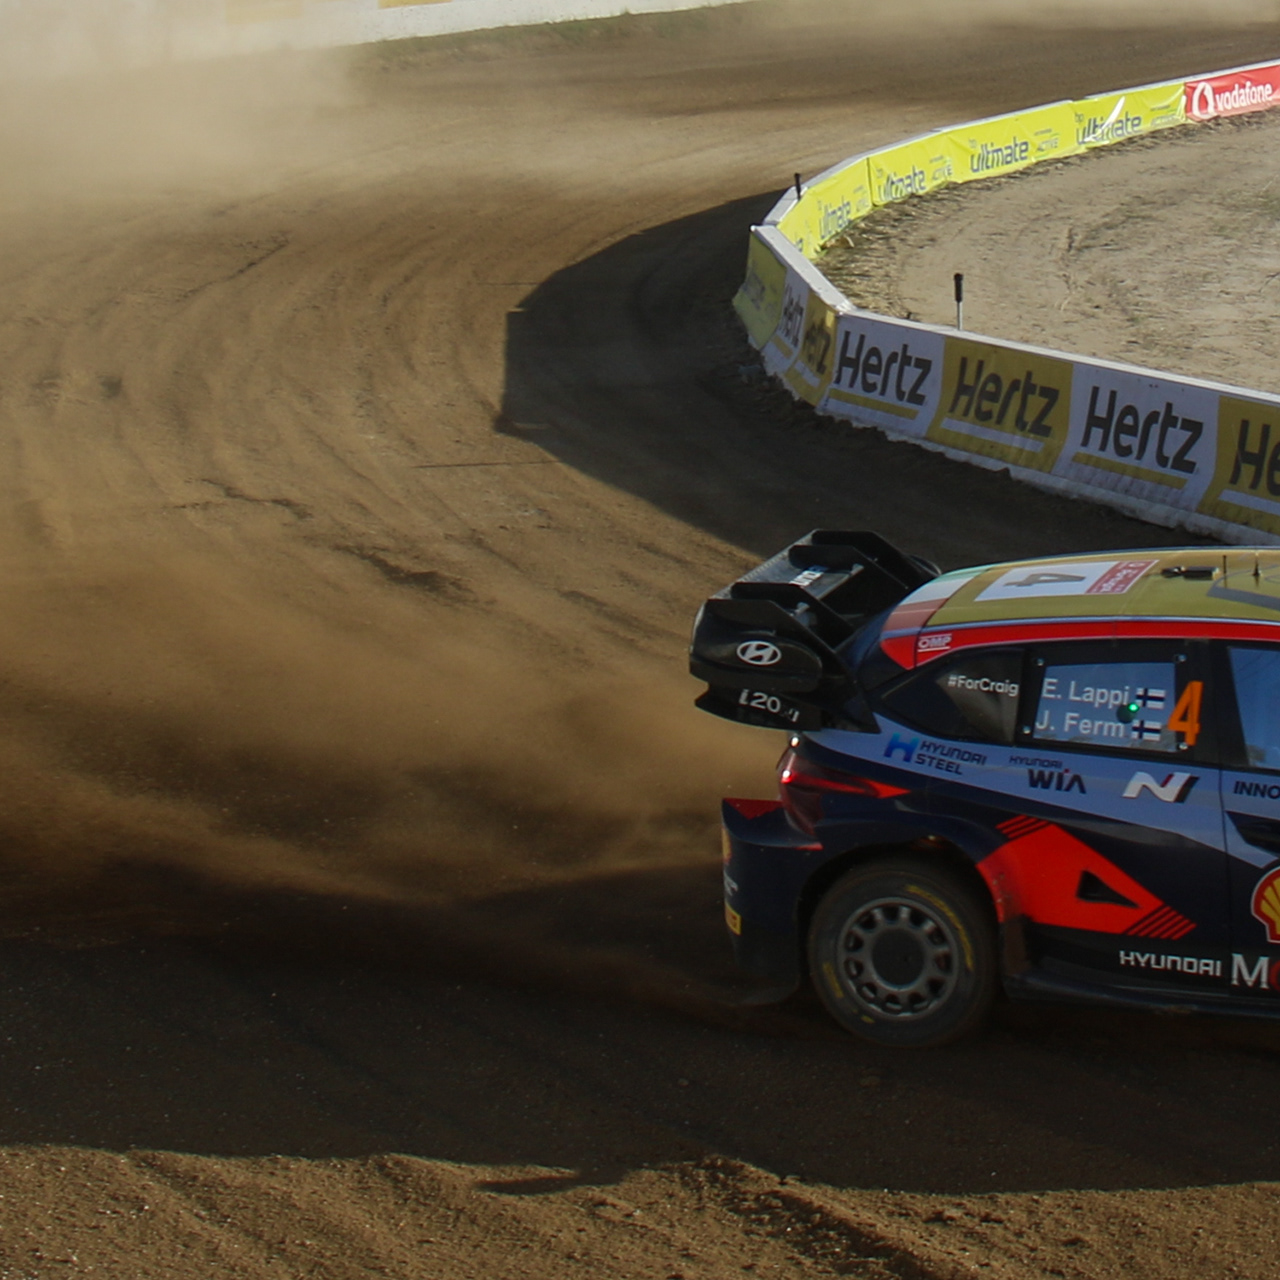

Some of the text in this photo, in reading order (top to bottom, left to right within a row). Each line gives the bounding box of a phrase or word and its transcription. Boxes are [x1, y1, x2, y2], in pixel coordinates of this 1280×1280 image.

[1215, 82, 1272, 111] vodafone
[1076, 112, 1142, 146] ultimate
[970, 138, 1029, 174] ultimate
[834, 330, 932, 407] Hertz
[949, 356, 1060, 438] Hertz
[1081, 386, 1204, 475] Hertz
[918, 634, 952, 650] OMP
[947, 673, 1019, 697] #ForCraig
[1042, 677, 1129, 708] E. Lappi
[739, 688, 781, 713] i20
[1167, 680, 1204, 747] 4
[1035, 709, 1125, 738] J. Ferm
[915, 754, 964, 776] STEEL
[920, 740, 987, 766] HYUNDAI
[1009, 755, 1063, 769] HYUNDAI
[1028, 768, 1087, 795] WIA
[1120, 950, 1222, 977] HYUNDAI
